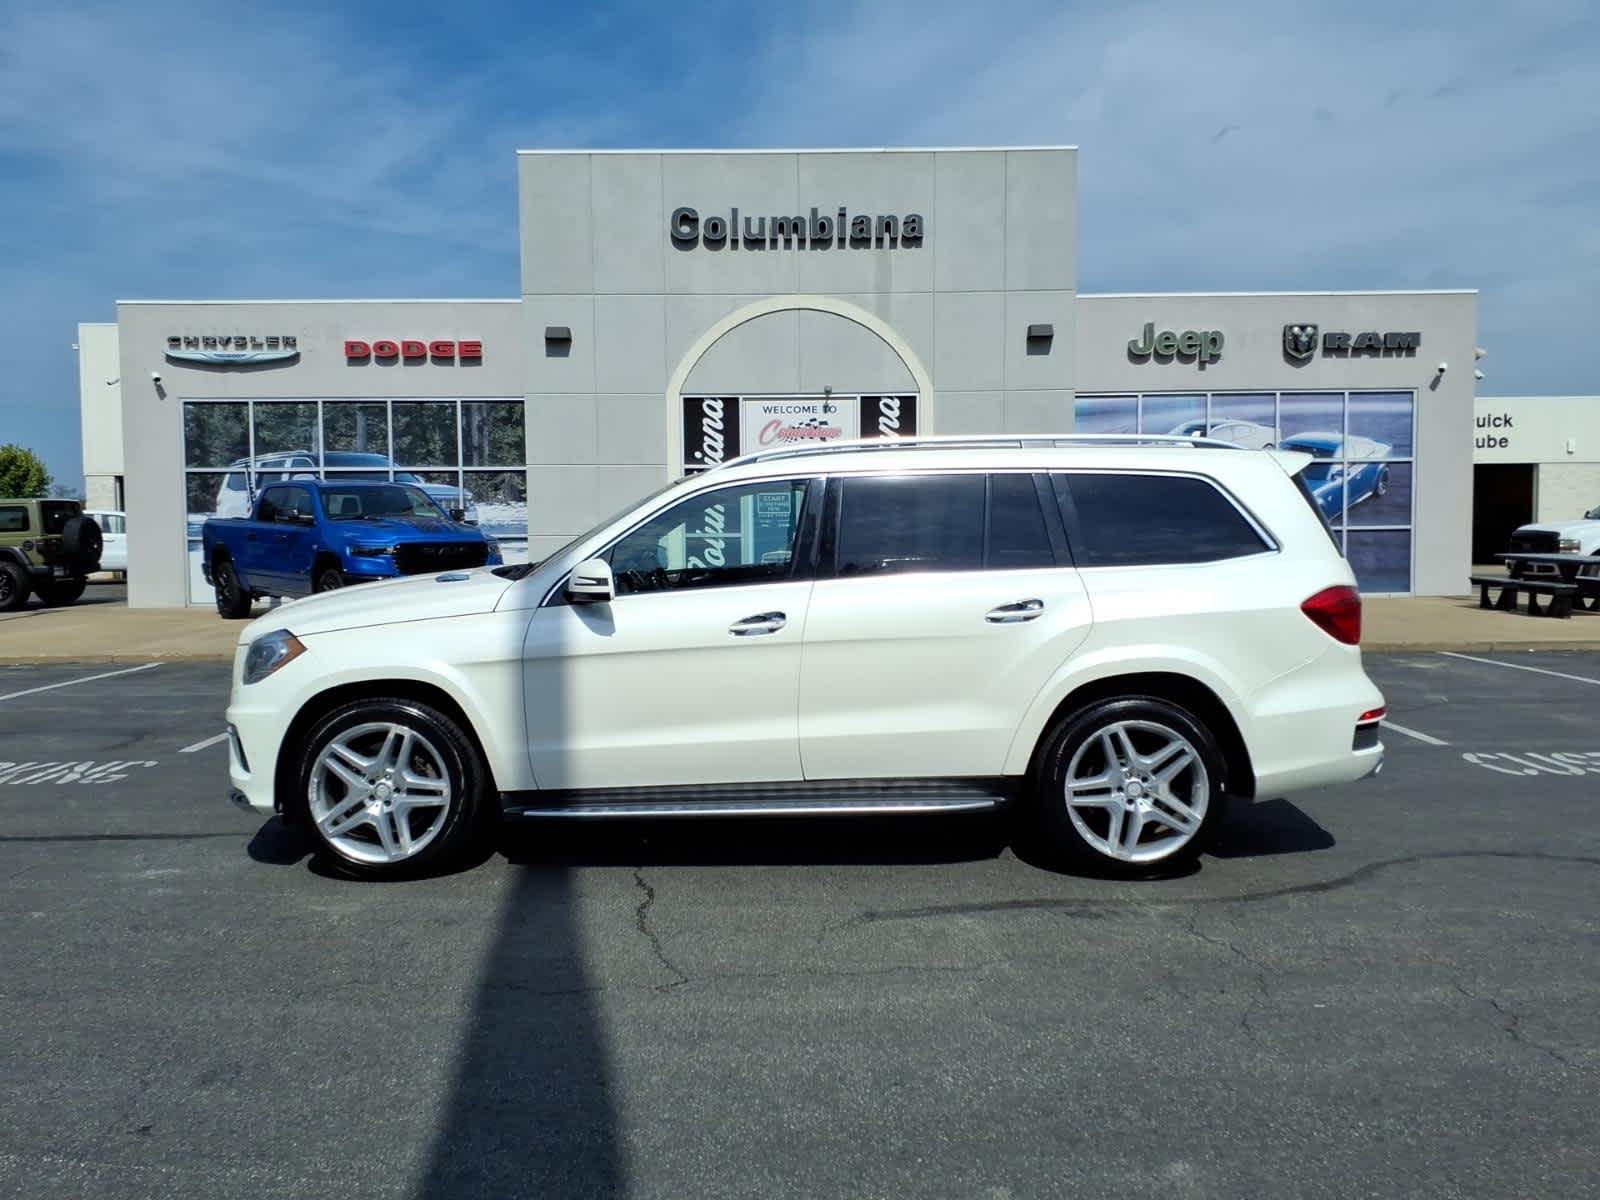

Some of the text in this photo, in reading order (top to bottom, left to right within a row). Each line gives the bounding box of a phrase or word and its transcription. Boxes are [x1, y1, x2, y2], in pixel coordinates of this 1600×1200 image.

[671, 206, 924, 246] Columbiana
[167, 336, 297, 348] CHRYSLER
[345, 340, 482, 361] DODGE
[1127, 322, 1225, 364] Jeep
[1323, 331, 1421, 353] RAM
[762, 405, 817, 415] WELCOME
[1475, 413, 1513, 428] uick
[1475, 434, 1509, 449] ube
